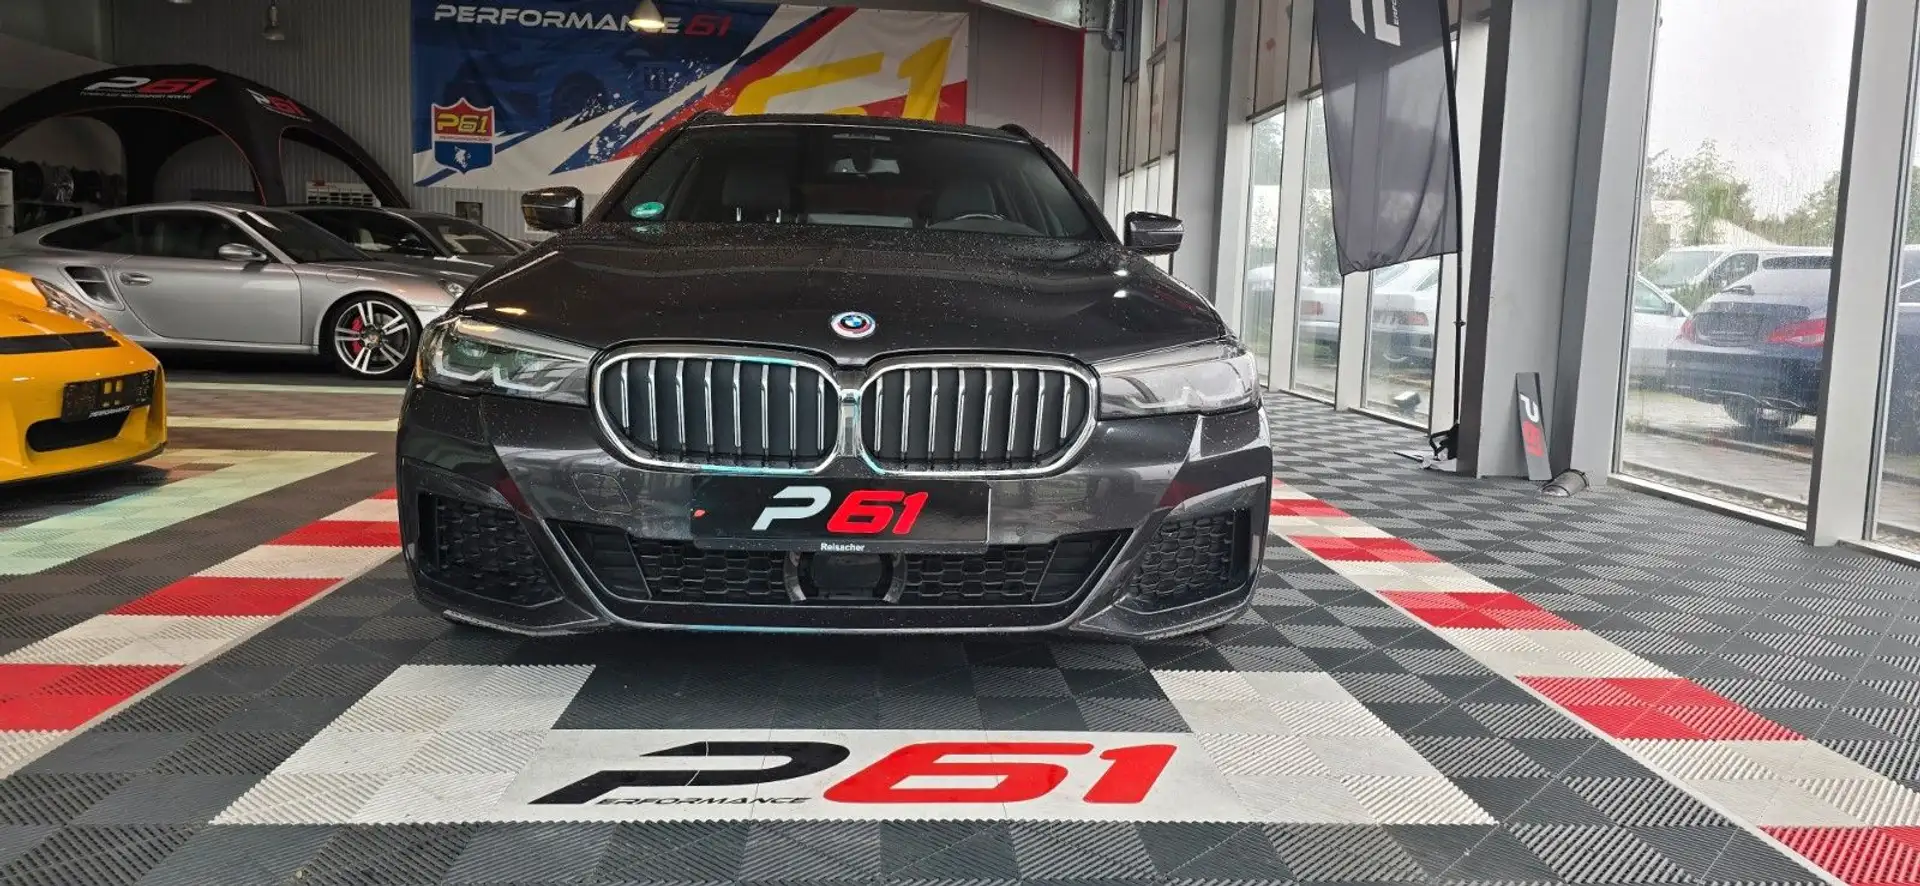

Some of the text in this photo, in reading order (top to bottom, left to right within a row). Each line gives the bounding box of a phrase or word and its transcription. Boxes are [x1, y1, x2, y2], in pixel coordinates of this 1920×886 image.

[434, 4, 733, 37] PERFORMANE 61
[83, 76, 217, 94] P61
[437, 113, 489, 133] P61
[751, 485, 929, 535] P61
[820, 542, 866, 551] Reisacher
[527, 740, 1178, 805] P61
